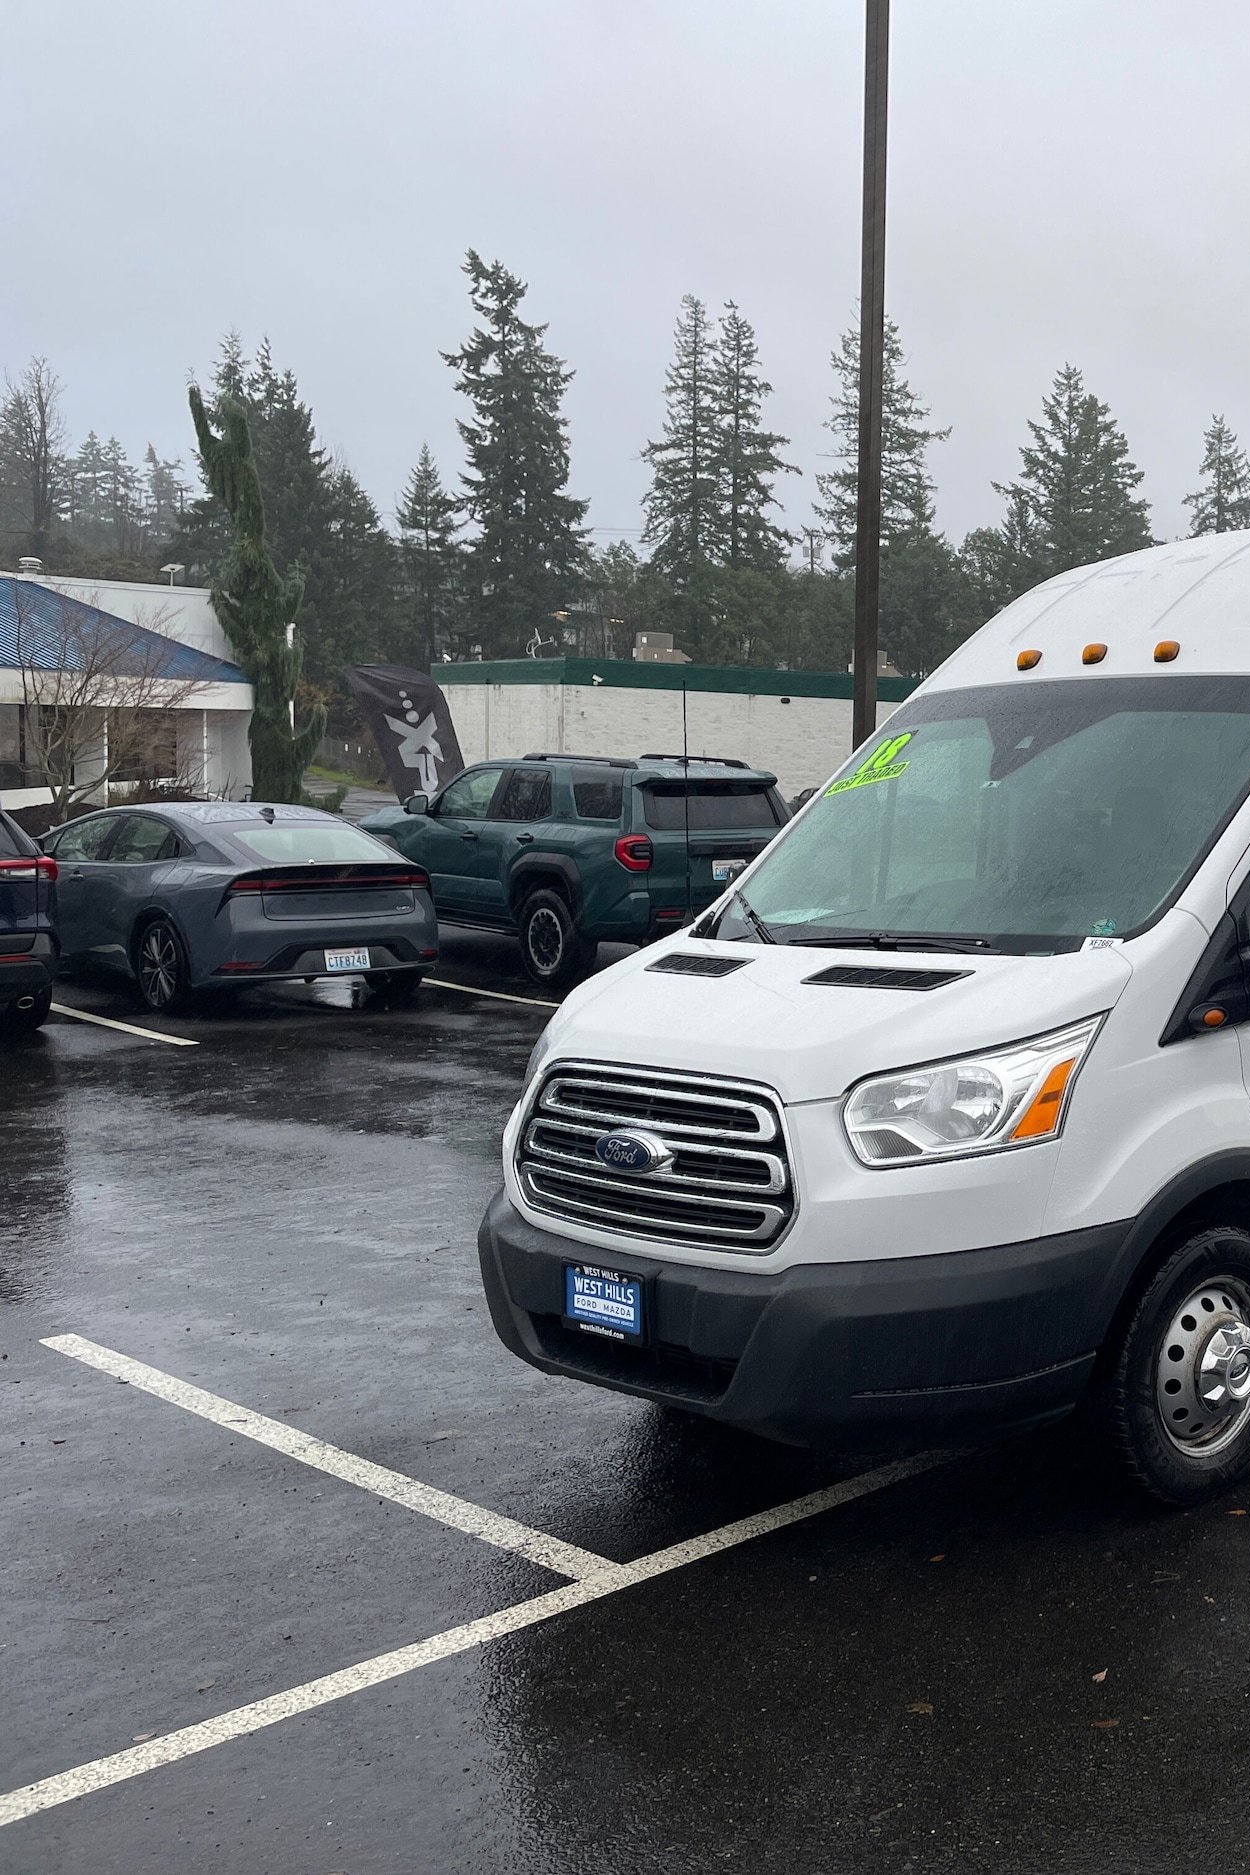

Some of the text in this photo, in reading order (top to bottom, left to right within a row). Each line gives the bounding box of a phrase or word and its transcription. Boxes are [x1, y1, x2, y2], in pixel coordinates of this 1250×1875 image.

[856, 732, 912, 775] 18
[828, 763, 907, 794] JUST TRADED
[604, 1139, 638, 1164] Ford
[583, 1266, 620, 1282] WEST HILLS
[574, 1276, 634, 1305] WEST HILLS
[577, 1298, 631, 1316] FORD MAZDA
